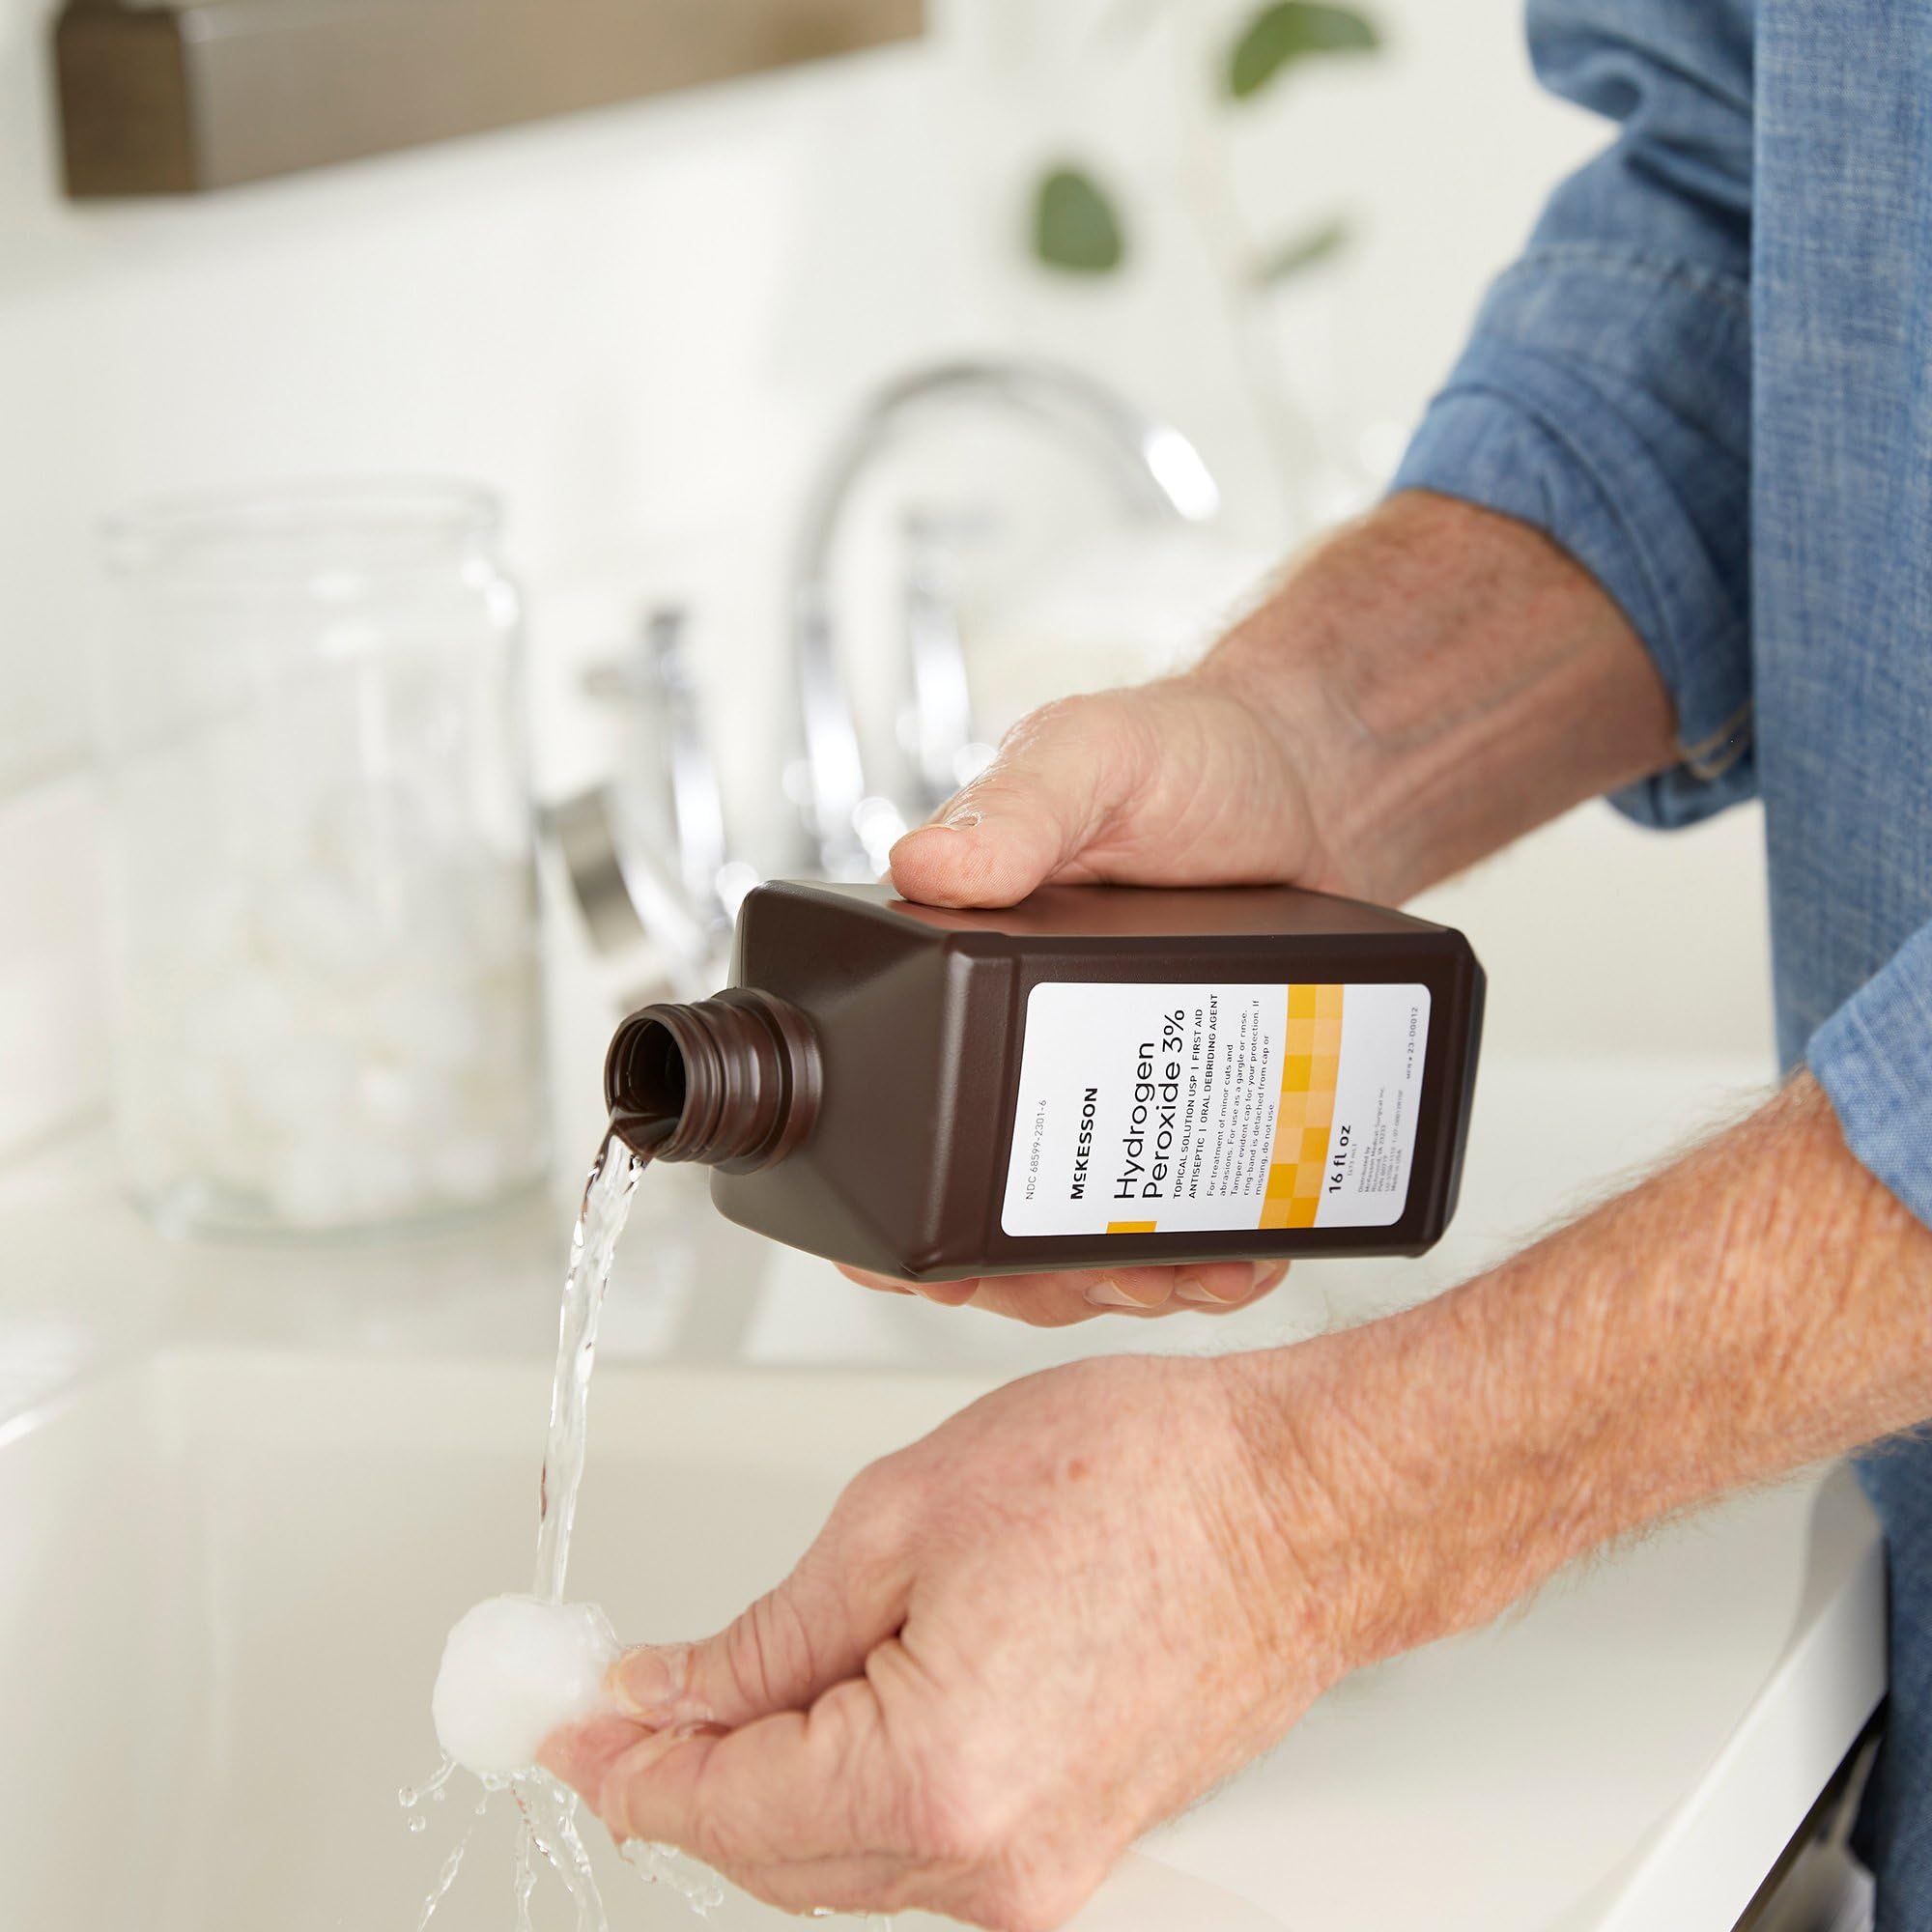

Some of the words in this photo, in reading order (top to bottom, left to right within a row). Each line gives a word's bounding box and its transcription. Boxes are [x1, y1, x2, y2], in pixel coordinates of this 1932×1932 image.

[1191, 1030, 1201, 1060] FIRST
[1204, 1033, 1215, 1092] DEBRIDING
[1142, 1061, 1180, 1198] Peroxide
[1161, 1009, 1184, 1053] 3%
[1188, 1074, 1197, 1095] USP
[1220, 1087, 1229, 1116] minor
[1230, 1159, 1242, 1195] Tamper
[1238, 1123, 1248, 1157] evident
[1243, 1103, 1252, 1121] cap
[1250, 1010, 1259, 1061] protection.
[1113, 1042, 1155, 1198] Hydrogen
[1180, 1099, 1194, 1151] SOLUTION
[1200, 1095, 1210, 1122] ORAL
[1219, 1148, 1233, 1196] abrasions.
[1227, 1128, 1236, 1144] For
[1236, 1053, 1245, 1084] gargle
[1242, 1150, 1256, 1195] ring-band
[1252, 1092, 1264, 1136] detached
[1258, 1066, 1266, 1089] from
[1029, 1099, 1046, 1173] 68599-2301-6
[1070, 1088, 1097, 1199] McKESSON
[1210, 1130, 1223, 1178] treatment
[1339, 1124, 1350, 1146] oz
[1173, 1154, 1187, 1198] TOPICAL
[1188, 1137, 1205, 1198] ANTISEPTIC
[1255, 1155, 1267, 1195] missing,
[1333, 1152, 1347, 1166] fl
[1025, 1176, 1036, 1199] NDC
[1206, 1180, 1215, 1196] For
[1328, 1173, 1343, 1193] 16
